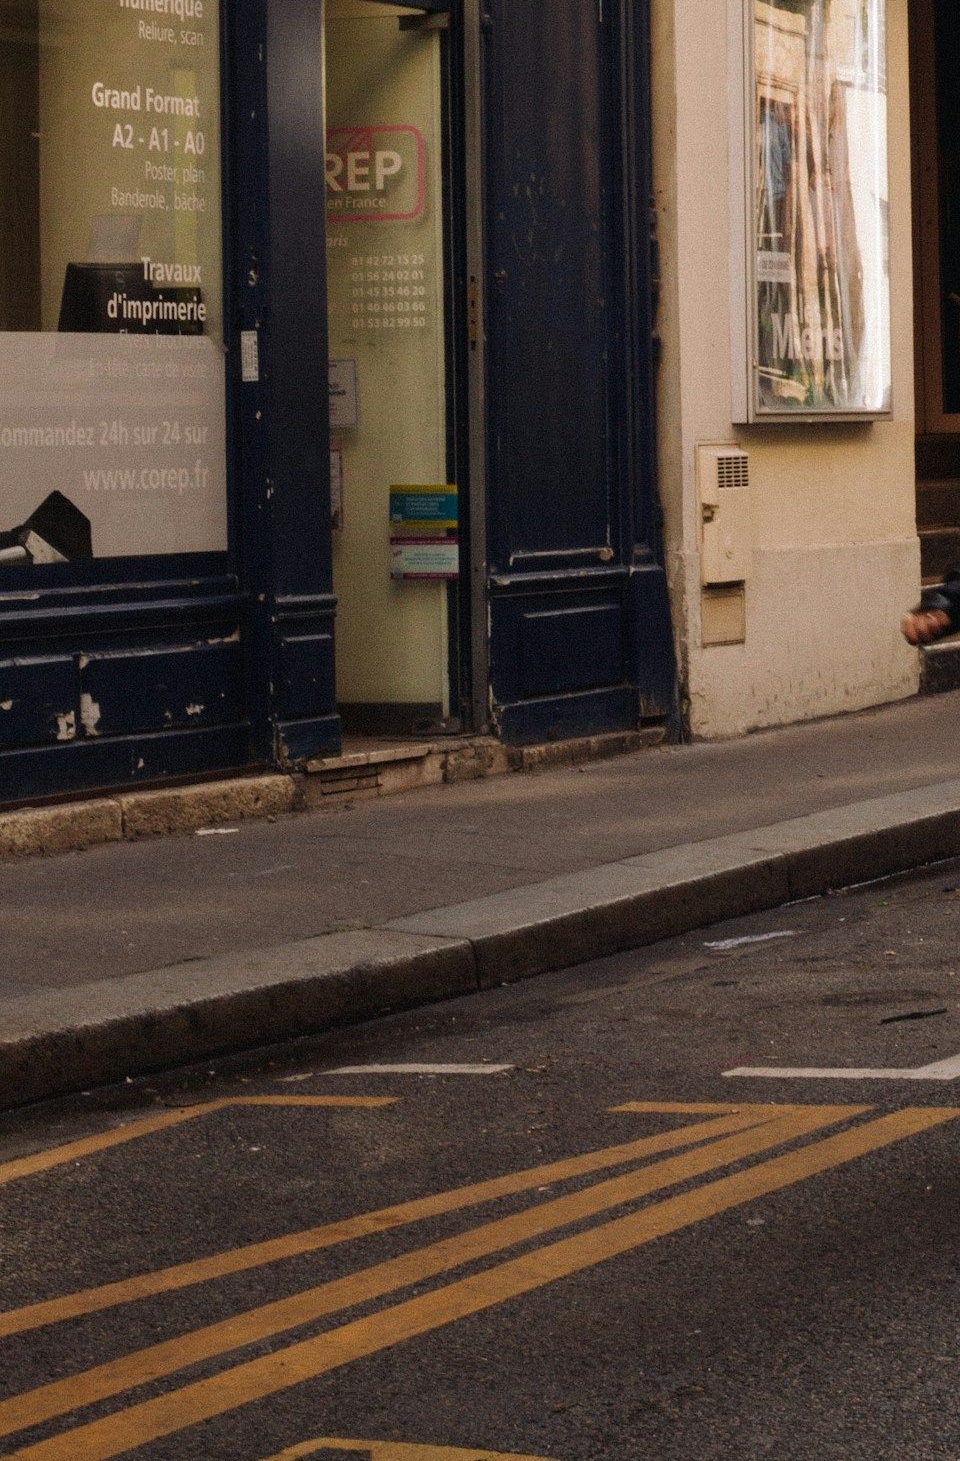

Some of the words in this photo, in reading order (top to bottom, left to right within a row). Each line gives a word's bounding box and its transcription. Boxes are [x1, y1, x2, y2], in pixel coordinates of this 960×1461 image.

[92, 82, 141, 111] Grand
[146, 87, 200, 117] Format
[112, 123, 134, 149] A2
[149, 127, 169, 151] A1
[184, 130, 205, 155] A0
[345, 196, 387, 208] France
[141, 256, 201, 282] Travaux
[107, 292, 207, 326] d'imprimerie
[82, 459, 210, 495] www.corep.fr
